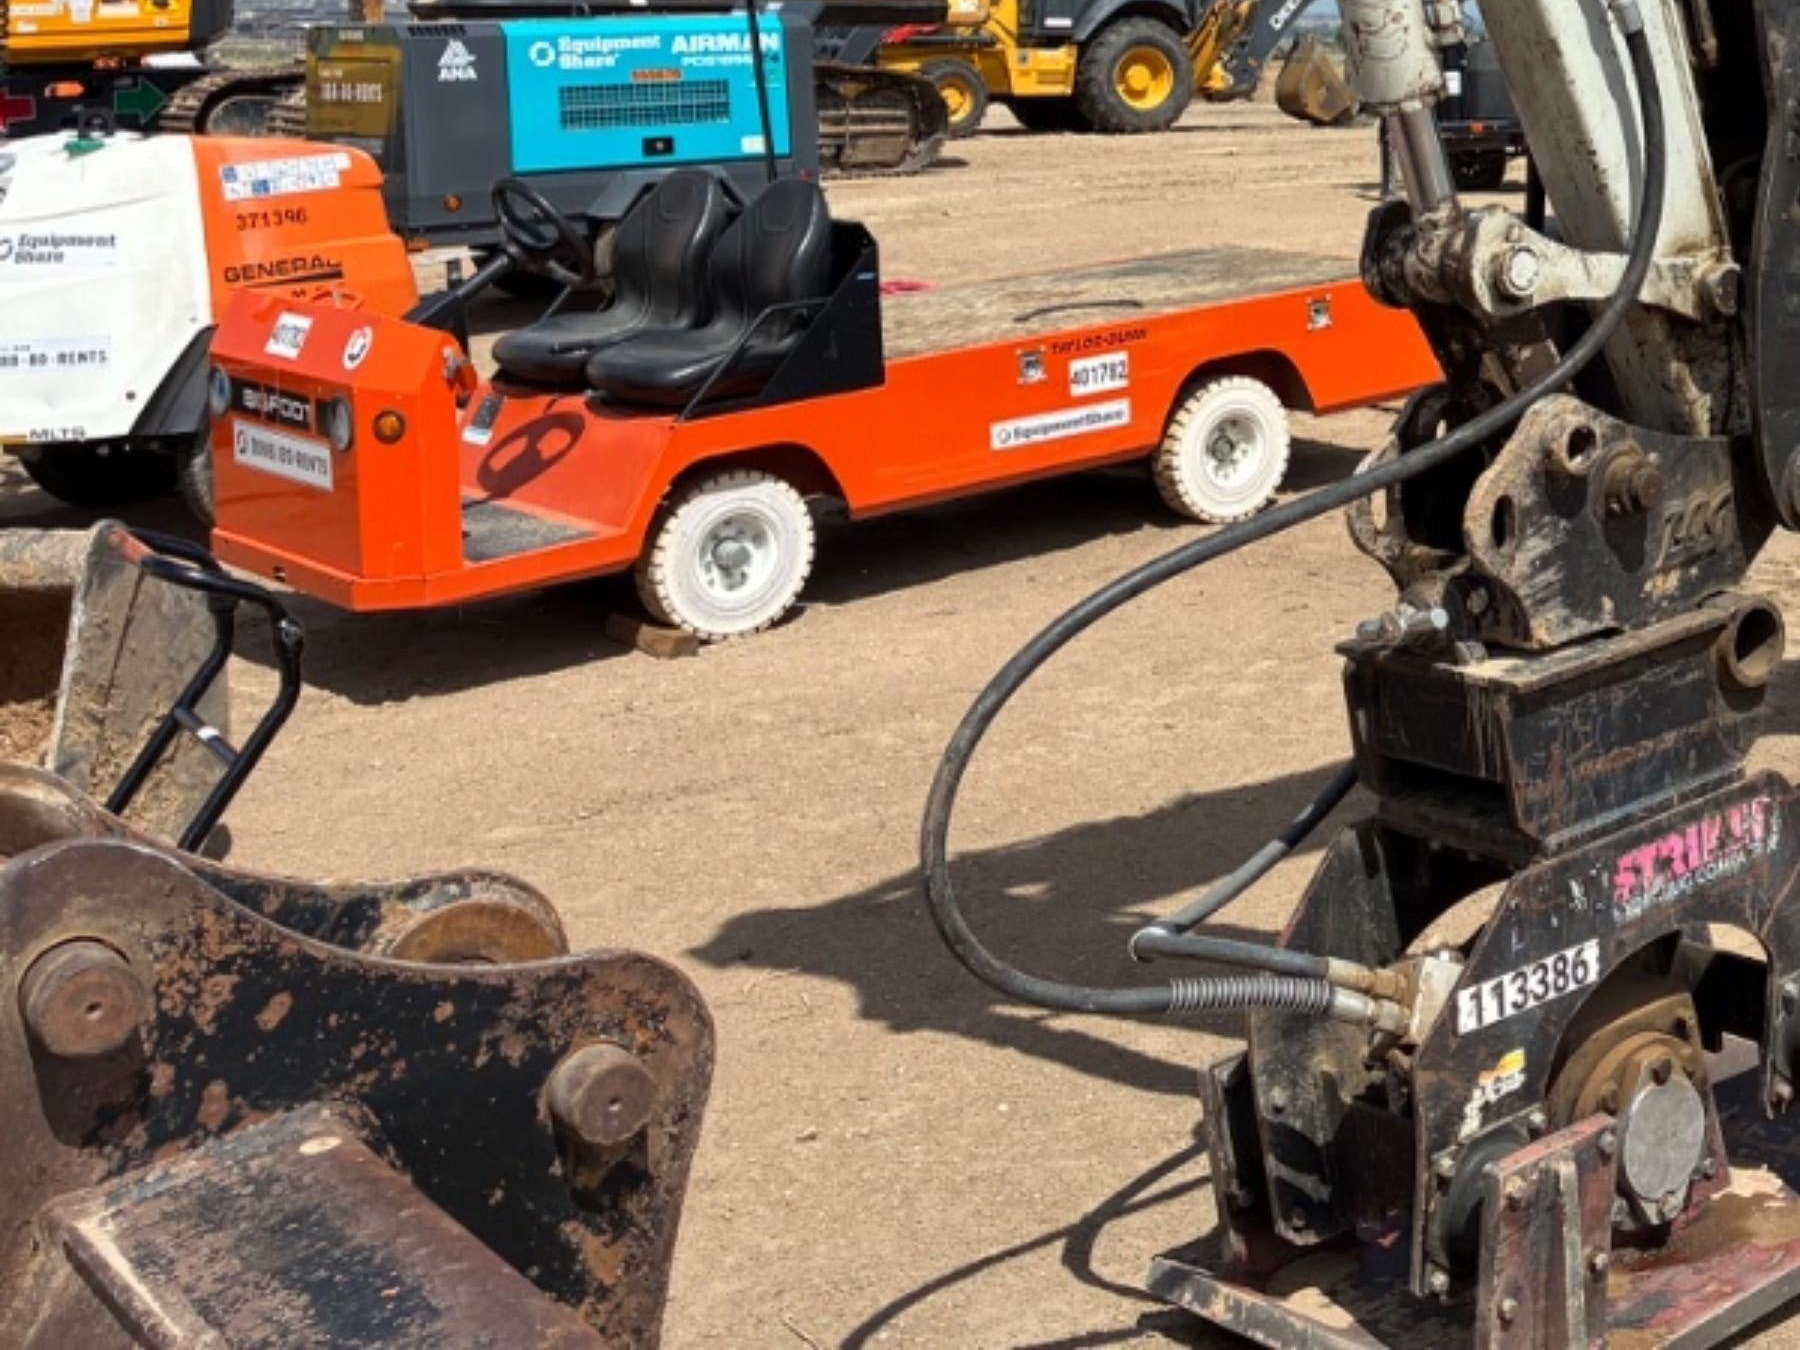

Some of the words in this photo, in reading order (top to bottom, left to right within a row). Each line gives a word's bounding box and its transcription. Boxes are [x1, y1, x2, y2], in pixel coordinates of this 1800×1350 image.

[558, 34, 661, 53] Equipment
[18, 233, 116, 250] Equipment
[14, 250, 64, 265] Share
[1071, 359, 1128, 387] 401782
[1469, 951, 1588, 1027] 113386
